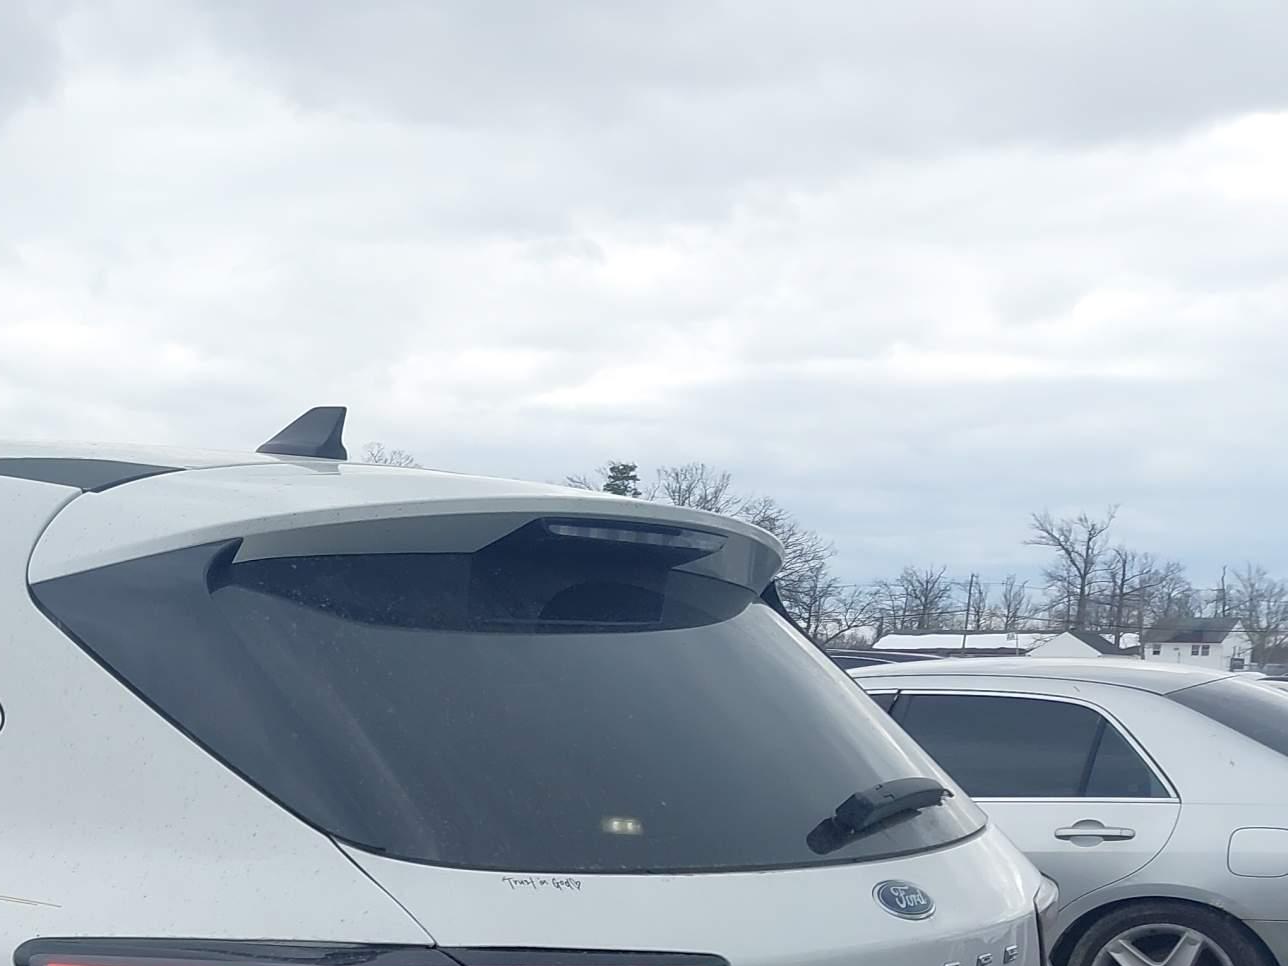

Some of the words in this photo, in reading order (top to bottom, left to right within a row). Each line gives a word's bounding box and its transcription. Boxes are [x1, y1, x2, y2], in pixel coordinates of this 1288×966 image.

[502, 876, 537, 889] Trust
[552, 877, 573, 890] God
[890, 886, 928, 909] Ford
